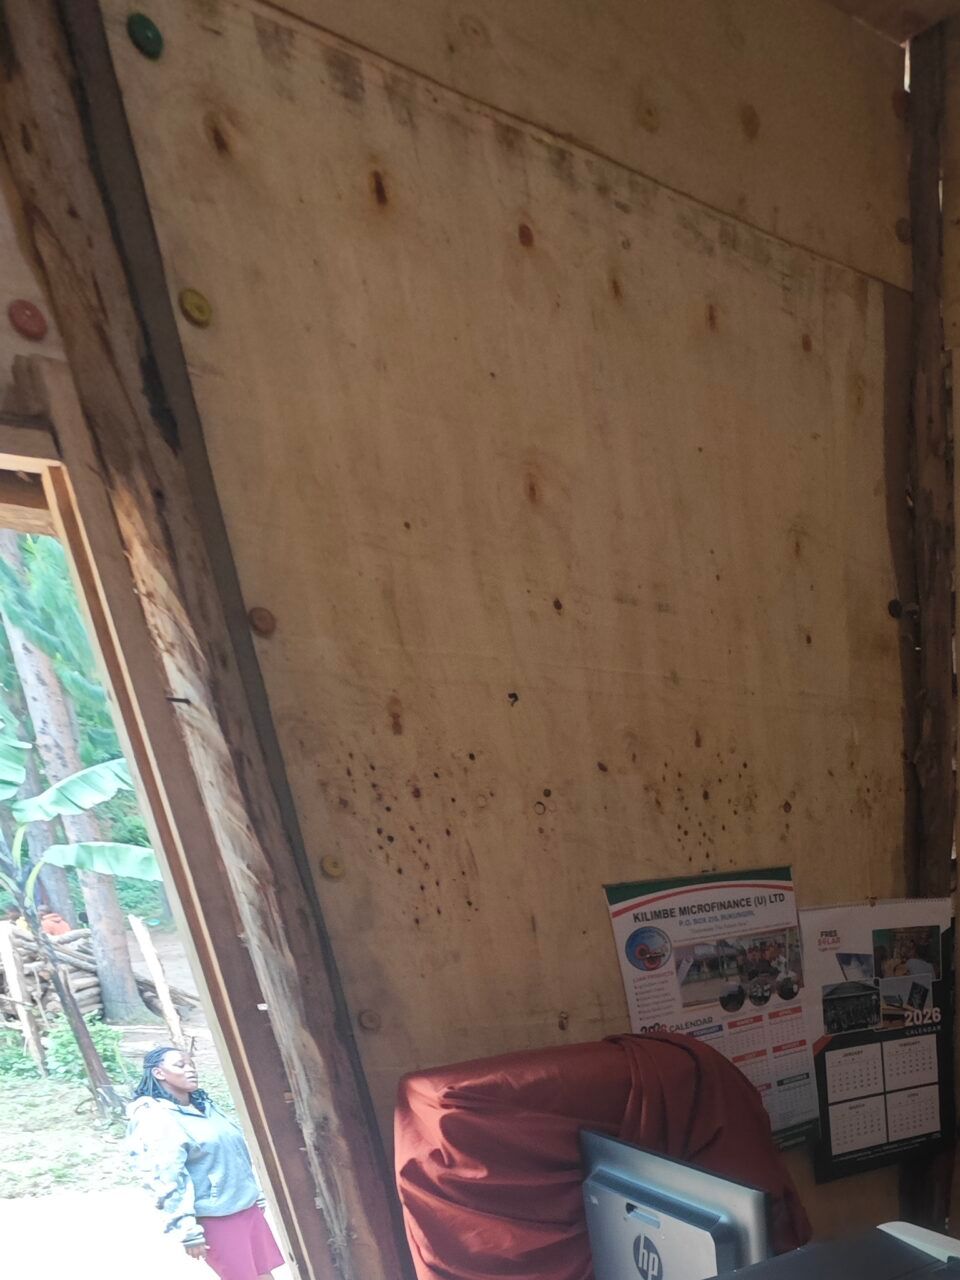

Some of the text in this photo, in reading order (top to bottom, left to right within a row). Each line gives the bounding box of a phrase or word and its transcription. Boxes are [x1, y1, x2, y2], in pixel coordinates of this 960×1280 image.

[633, 893, 785, 923] KILIMBE MICROFINANCE (U) LTD
[669, 1016, 713, 1033] CALENDAR
[904, 1007, 942, 1027] 2026
[905, 1025, 942, 1036] CALENDAR
